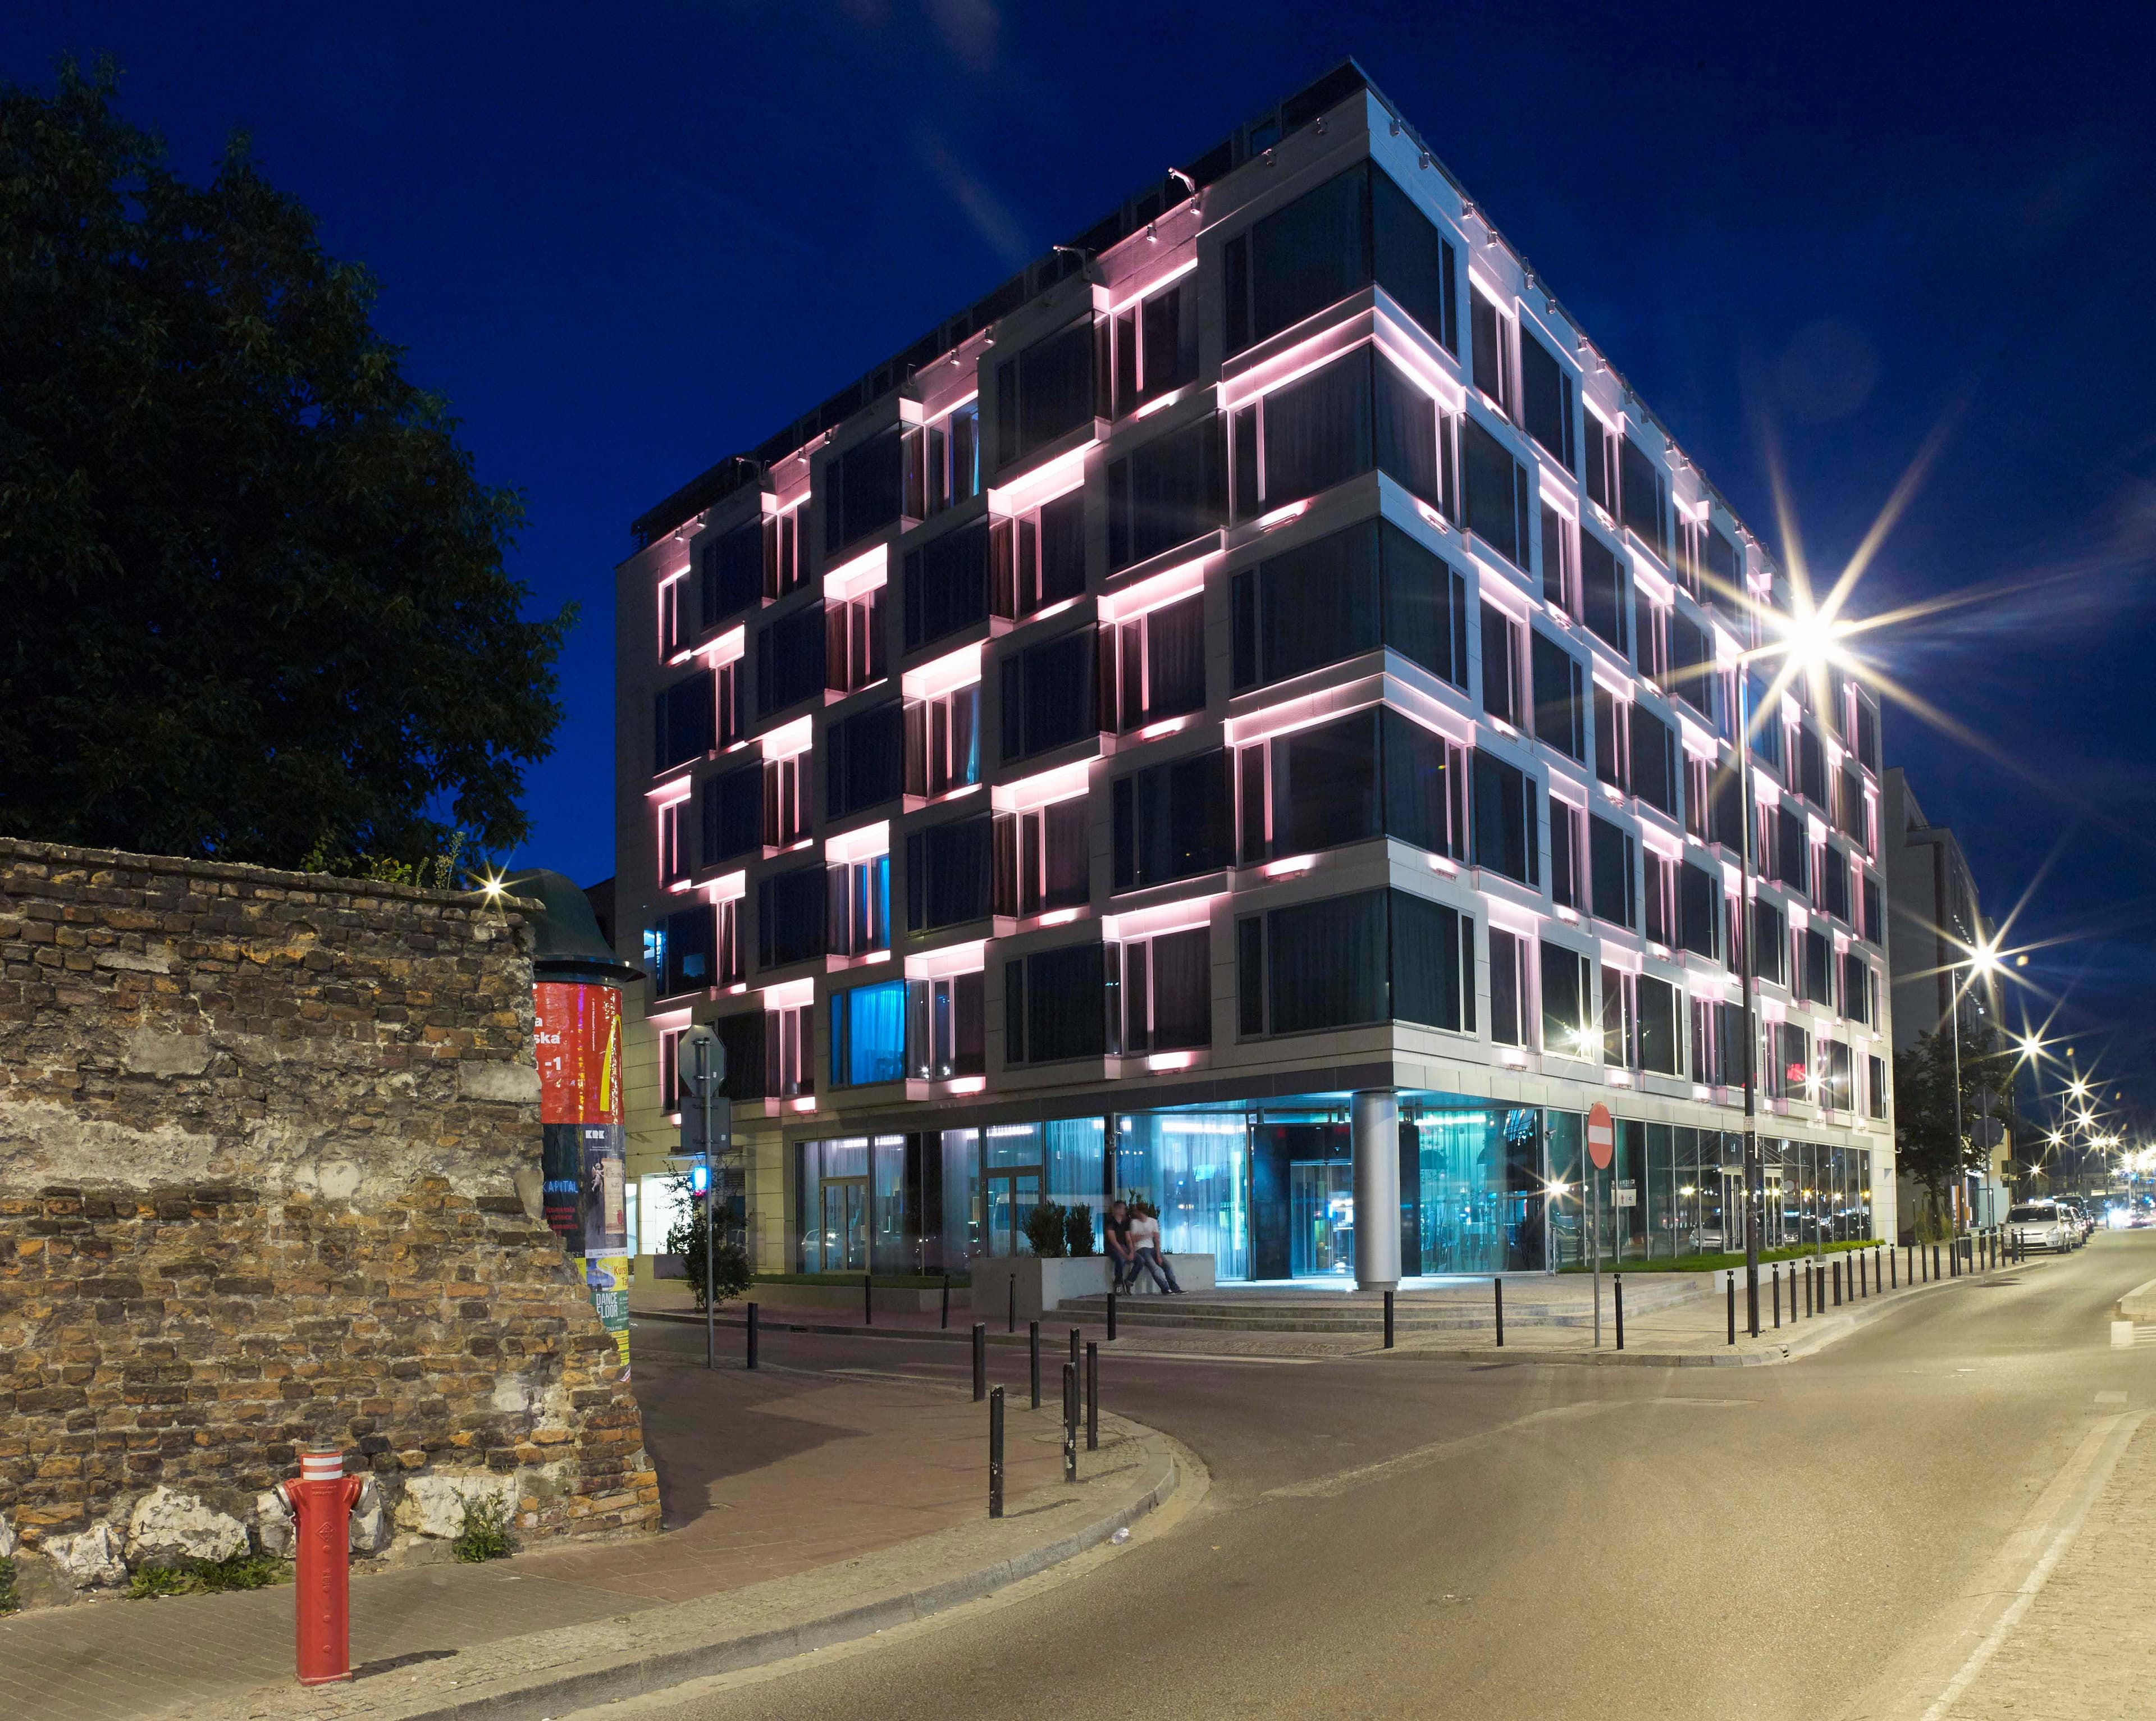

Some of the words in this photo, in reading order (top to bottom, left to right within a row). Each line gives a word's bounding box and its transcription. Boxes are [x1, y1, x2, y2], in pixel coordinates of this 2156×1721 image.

[585, 1130, 605, 1139] KRK
[596, 1292, 618, 1305] DANCE
[596, 1304, 618, 1318] FLOOR
